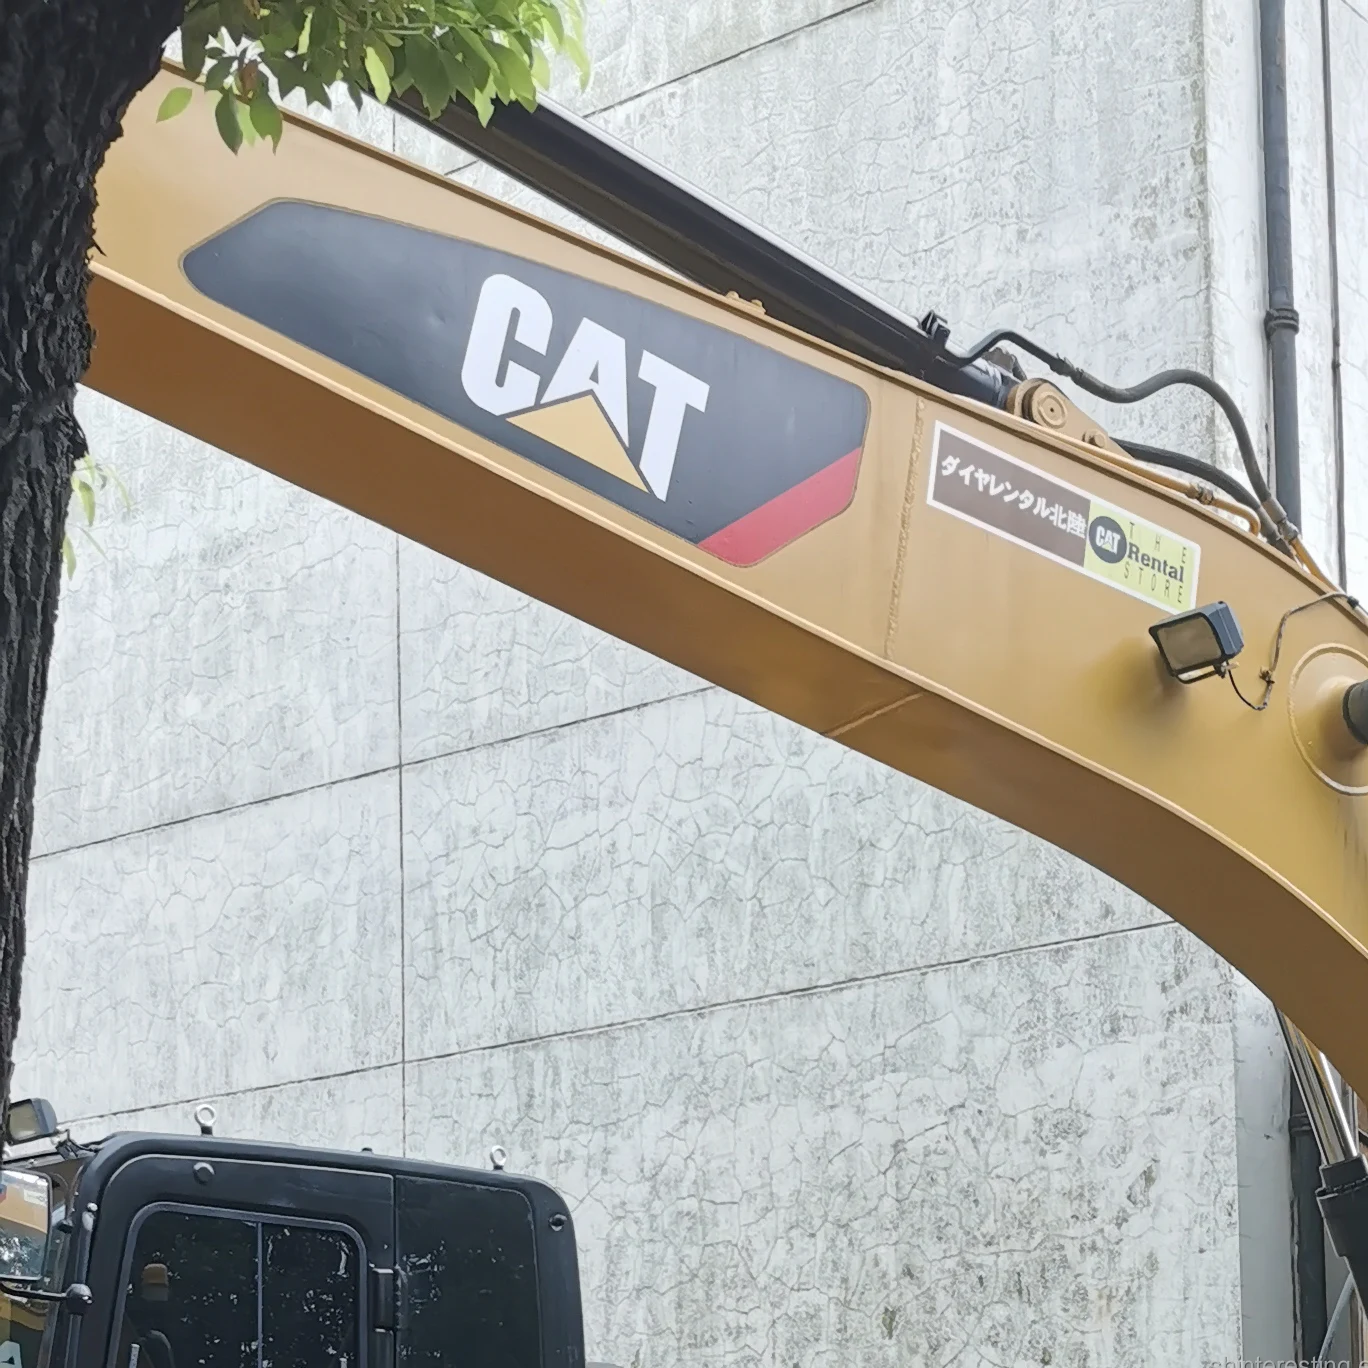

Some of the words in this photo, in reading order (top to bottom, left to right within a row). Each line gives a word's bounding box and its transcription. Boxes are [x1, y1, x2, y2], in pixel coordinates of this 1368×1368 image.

[461, 273, 710, 502] CAT
[941, 455, 1087, 539] ダイヤレンタル北陸
[1095, 525, 1121, 555] CAT
[1129, 521, 1188, 564] THE
[1123, 560, 1184, 604] STORE
[1127, 542, 1185, 584] Rental
